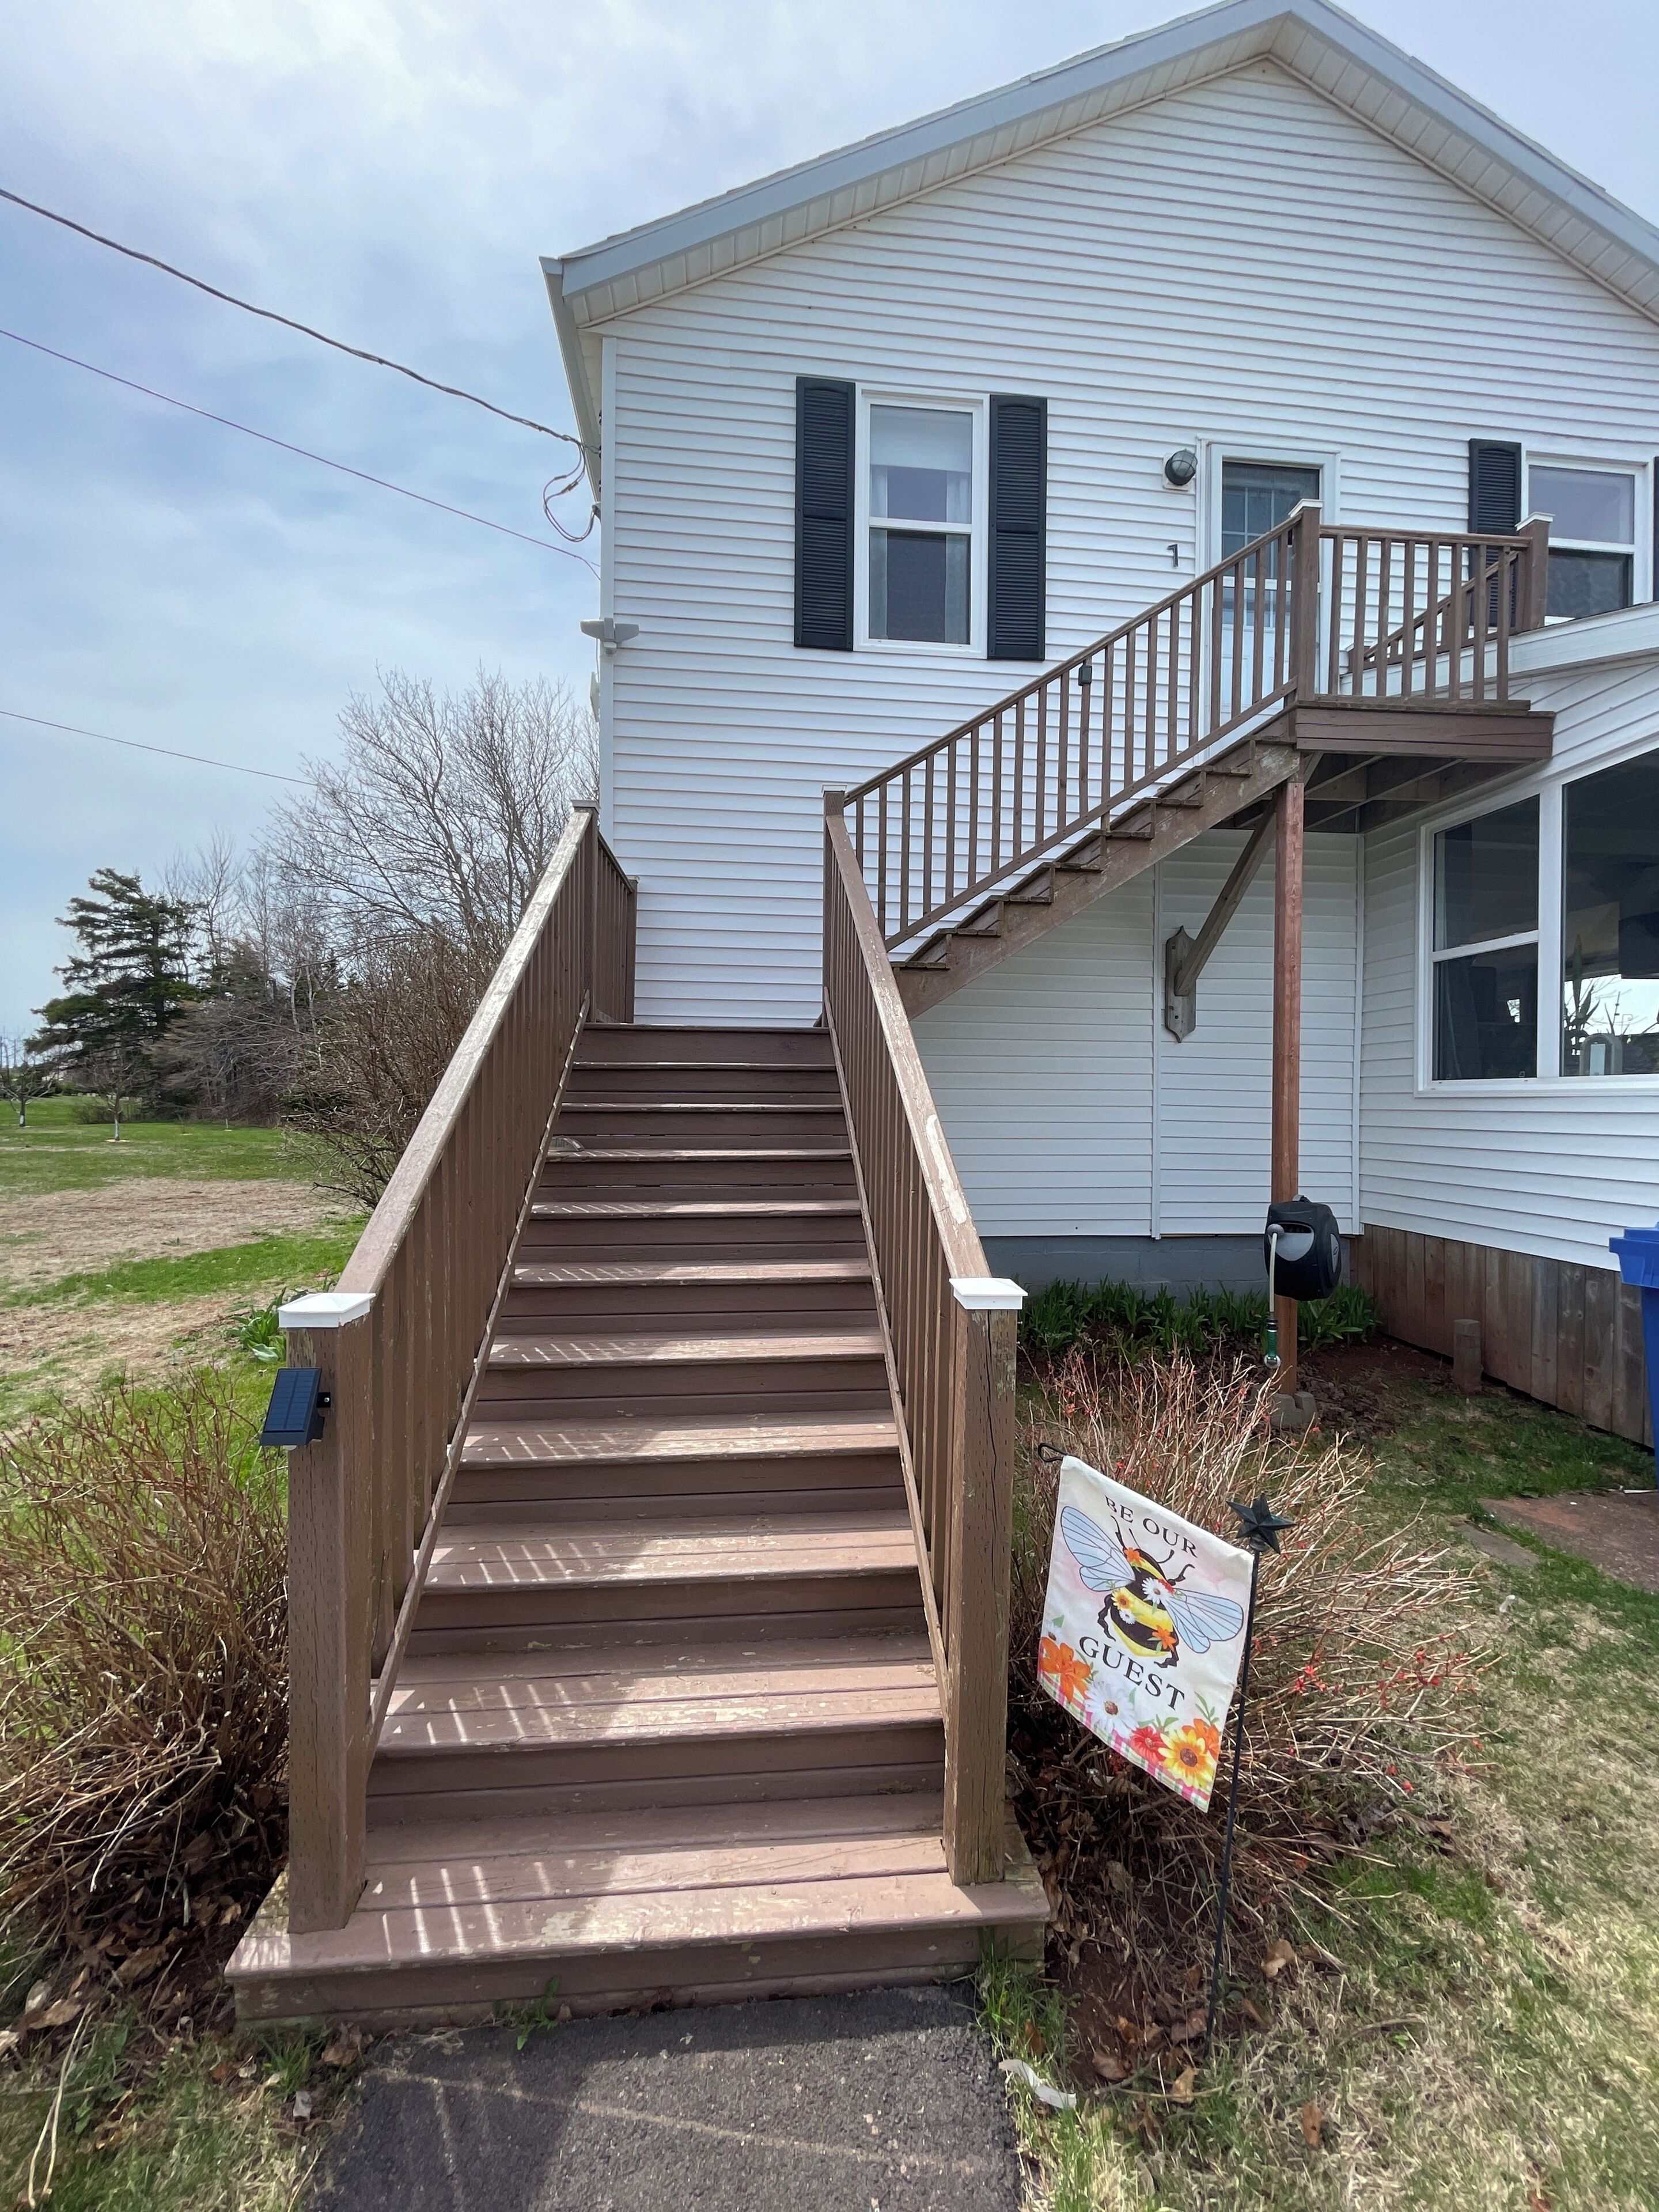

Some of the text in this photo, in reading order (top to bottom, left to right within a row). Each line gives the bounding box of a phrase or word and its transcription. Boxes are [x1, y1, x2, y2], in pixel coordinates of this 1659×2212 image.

[1105, 1495, 1198, 1558] BE OUR
[1079, 1636, 1185, 1711] GUEST
